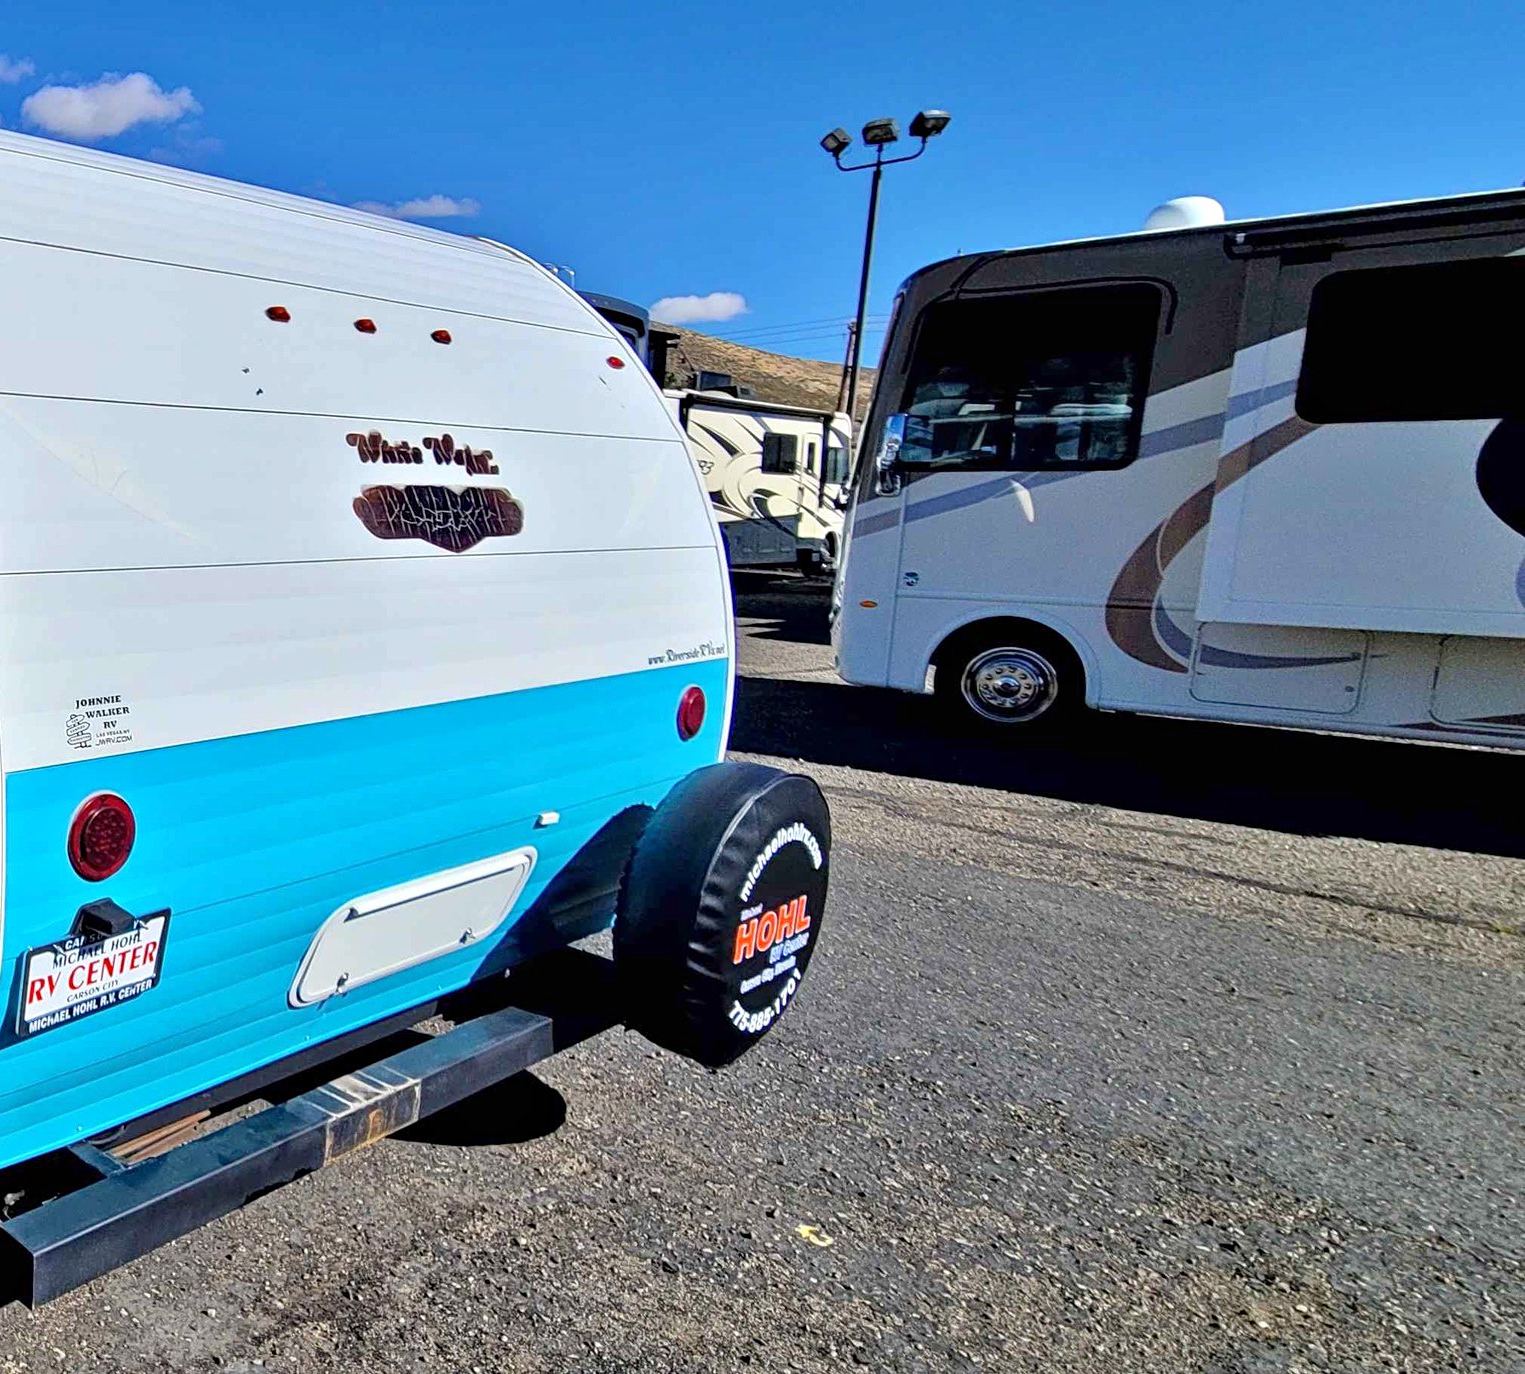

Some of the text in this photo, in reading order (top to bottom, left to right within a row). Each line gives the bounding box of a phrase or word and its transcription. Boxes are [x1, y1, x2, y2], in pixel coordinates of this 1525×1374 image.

[75, 695, 122, 709] JOHNNIE
[85, 706, 130, 719] WALKER
[103, 720, 117, 729] RV
[733, 894, 811, 965] HOHL
[53, 932, 142, 969] MICHAEL HOHL
[28, 941, 157, 1005] RV CENTER
[29, 1009, 71, 1033] MICHAEL
[72, 999, 98, 1016] HOHL
[118, 978, 153, 1000] CENTER
[67, 980, 119, 1003] CARSON CITY
